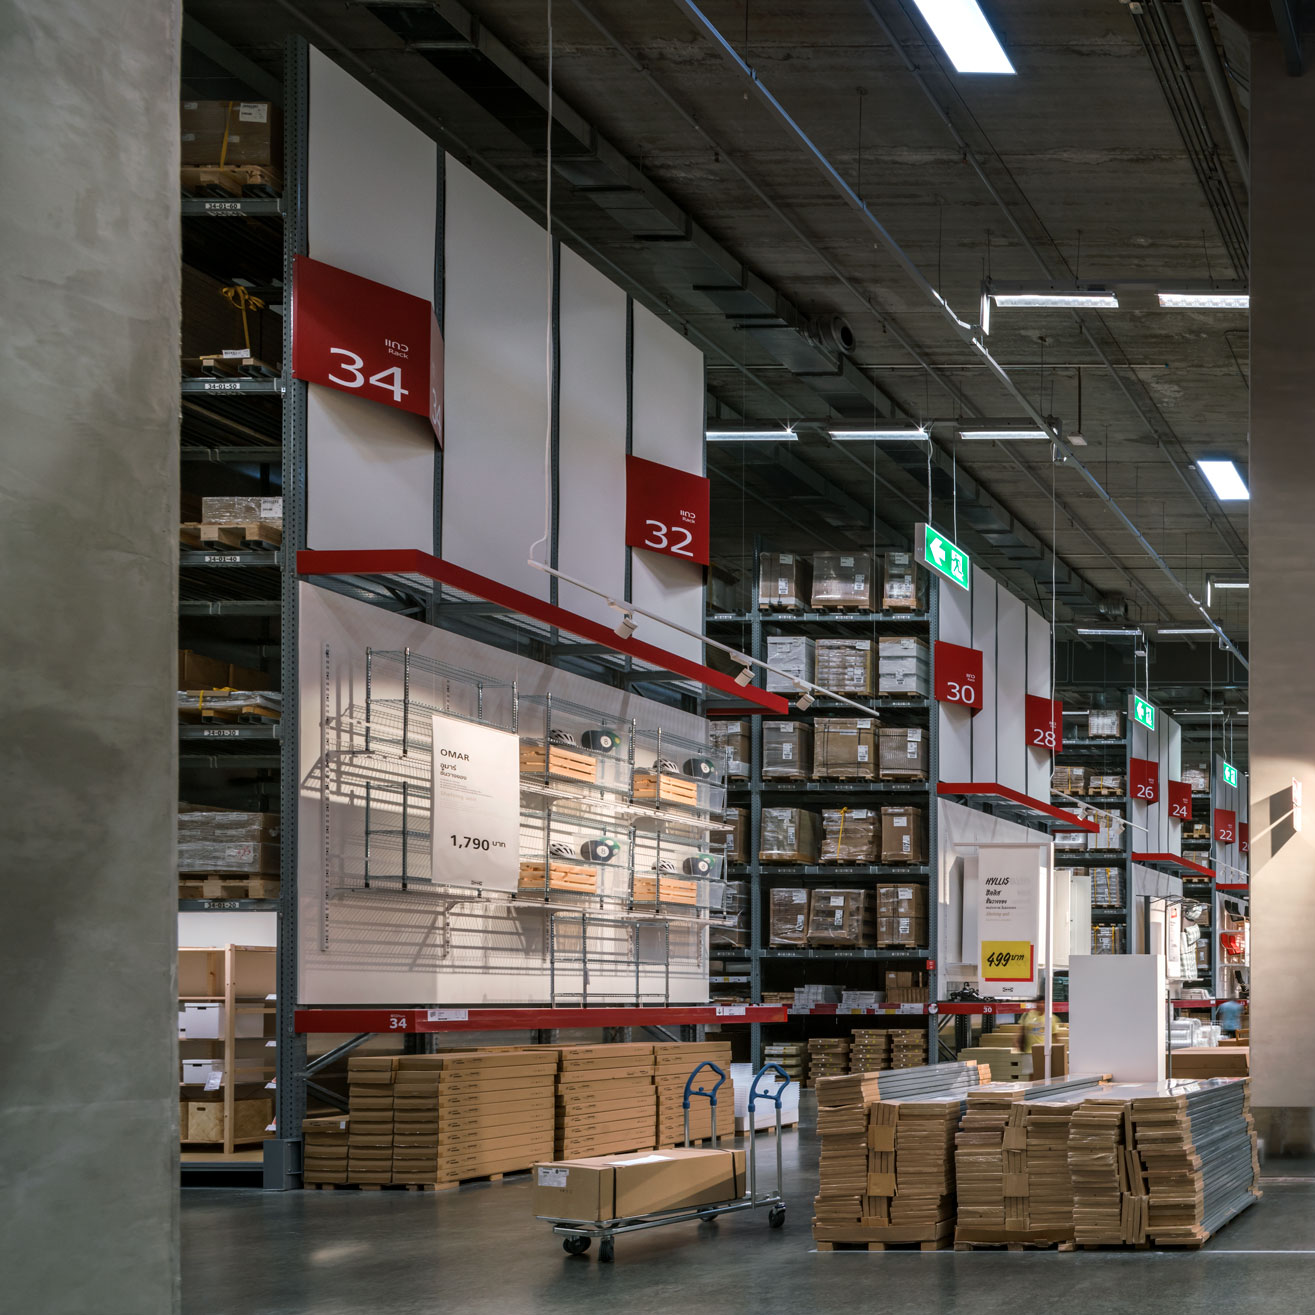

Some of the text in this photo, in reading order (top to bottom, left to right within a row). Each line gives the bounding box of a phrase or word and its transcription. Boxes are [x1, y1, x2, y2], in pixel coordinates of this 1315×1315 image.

[384, 338, 409, 353] แถว
[388, 348, 409, 359] Rack
[328, 347, 409, 402] 34
[680, 509, 696, 519] แถว
[645, 519, 694, 557] 32
[947, 681, 975, 704] 30
[1033, 728, 1056, 747] 28
[440, 748, 470, 762] OMAR
[1137, 784, 1154, 799] 26
[1172, 804, 1188, 817] 24
[1219, 829, 1233, 841] 22
[450, 834, 490, 851] 1,790
[1242, 841, 1248, 852] 2
[985, 876, 1010, 886] HYLLIS
[986, 952, 1010, 967] 499
[389, 1018, 407, 1029] 34
